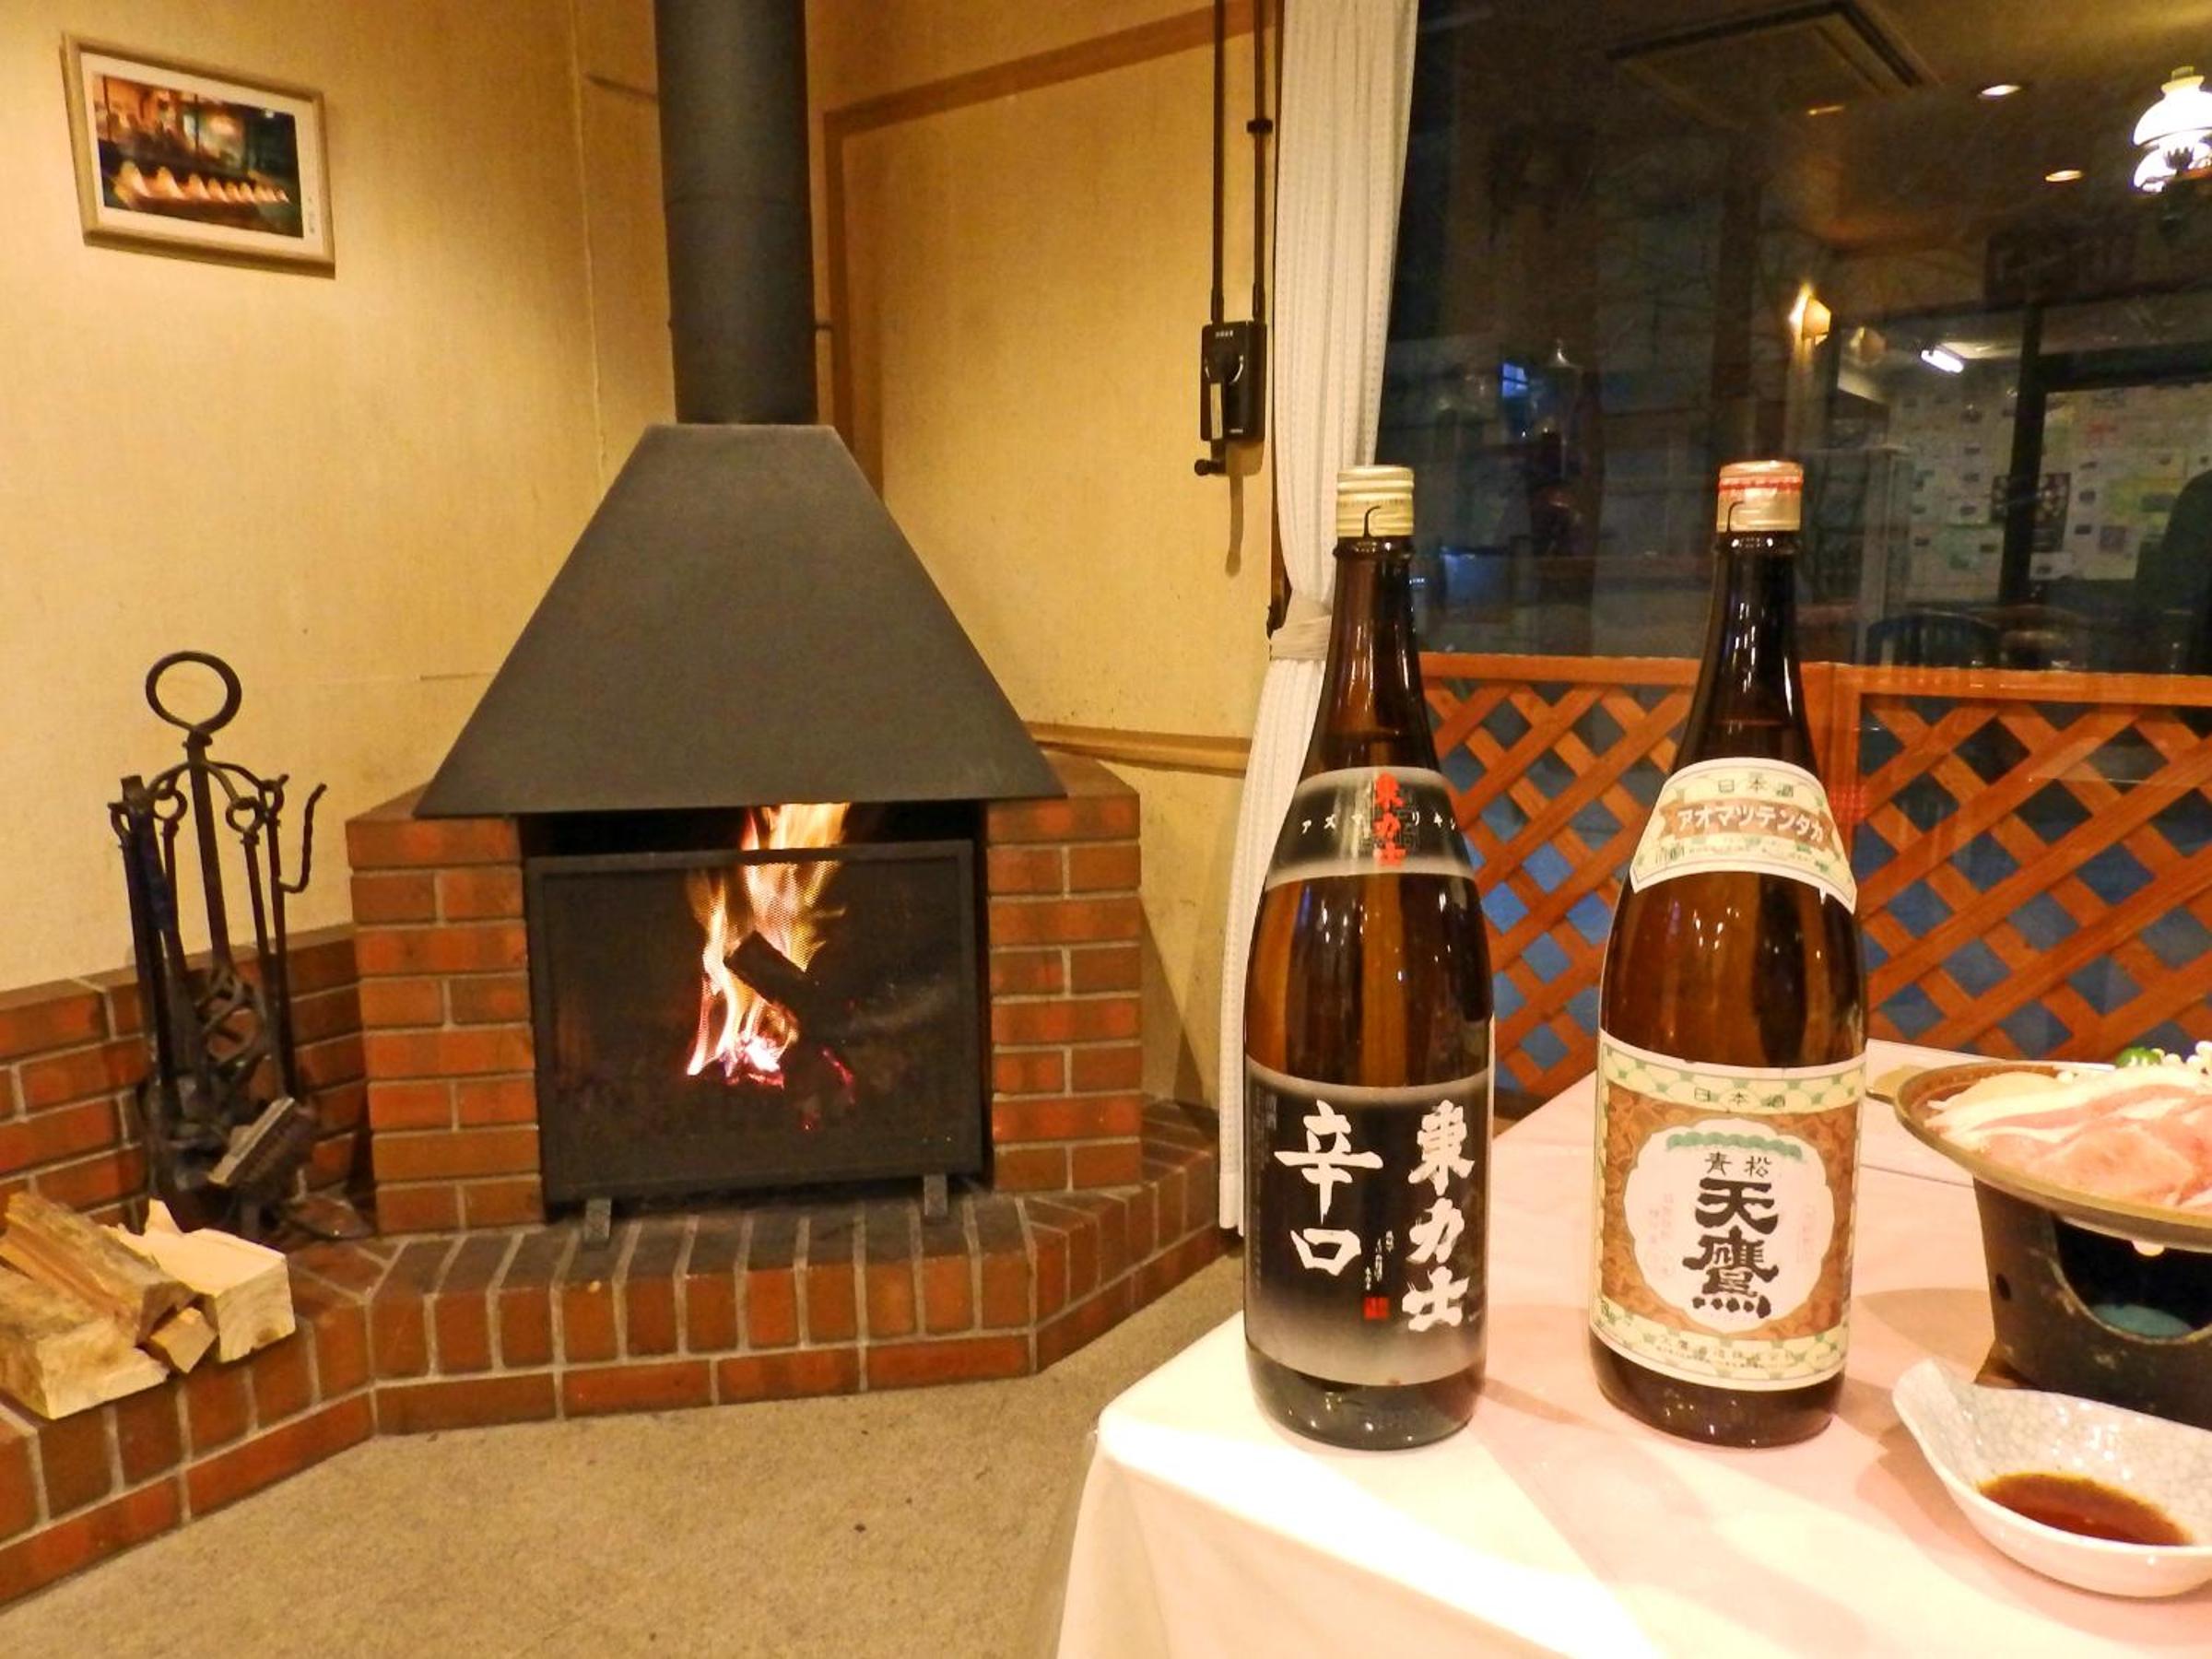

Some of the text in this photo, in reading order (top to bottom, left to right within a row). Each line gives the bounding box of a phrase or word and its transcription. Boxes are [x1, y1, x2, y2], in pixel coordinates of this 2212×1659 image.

[1677, 805, 1824, 842] アオマツテンタカ
[1274, 1100, 1383, 1276] 辛口
[1402, 1099, 1475, 1332] 東力士
[1704, 1151, 1772, 1178] 青松
[1683, 1177, 1779, 1319] 天鷹
